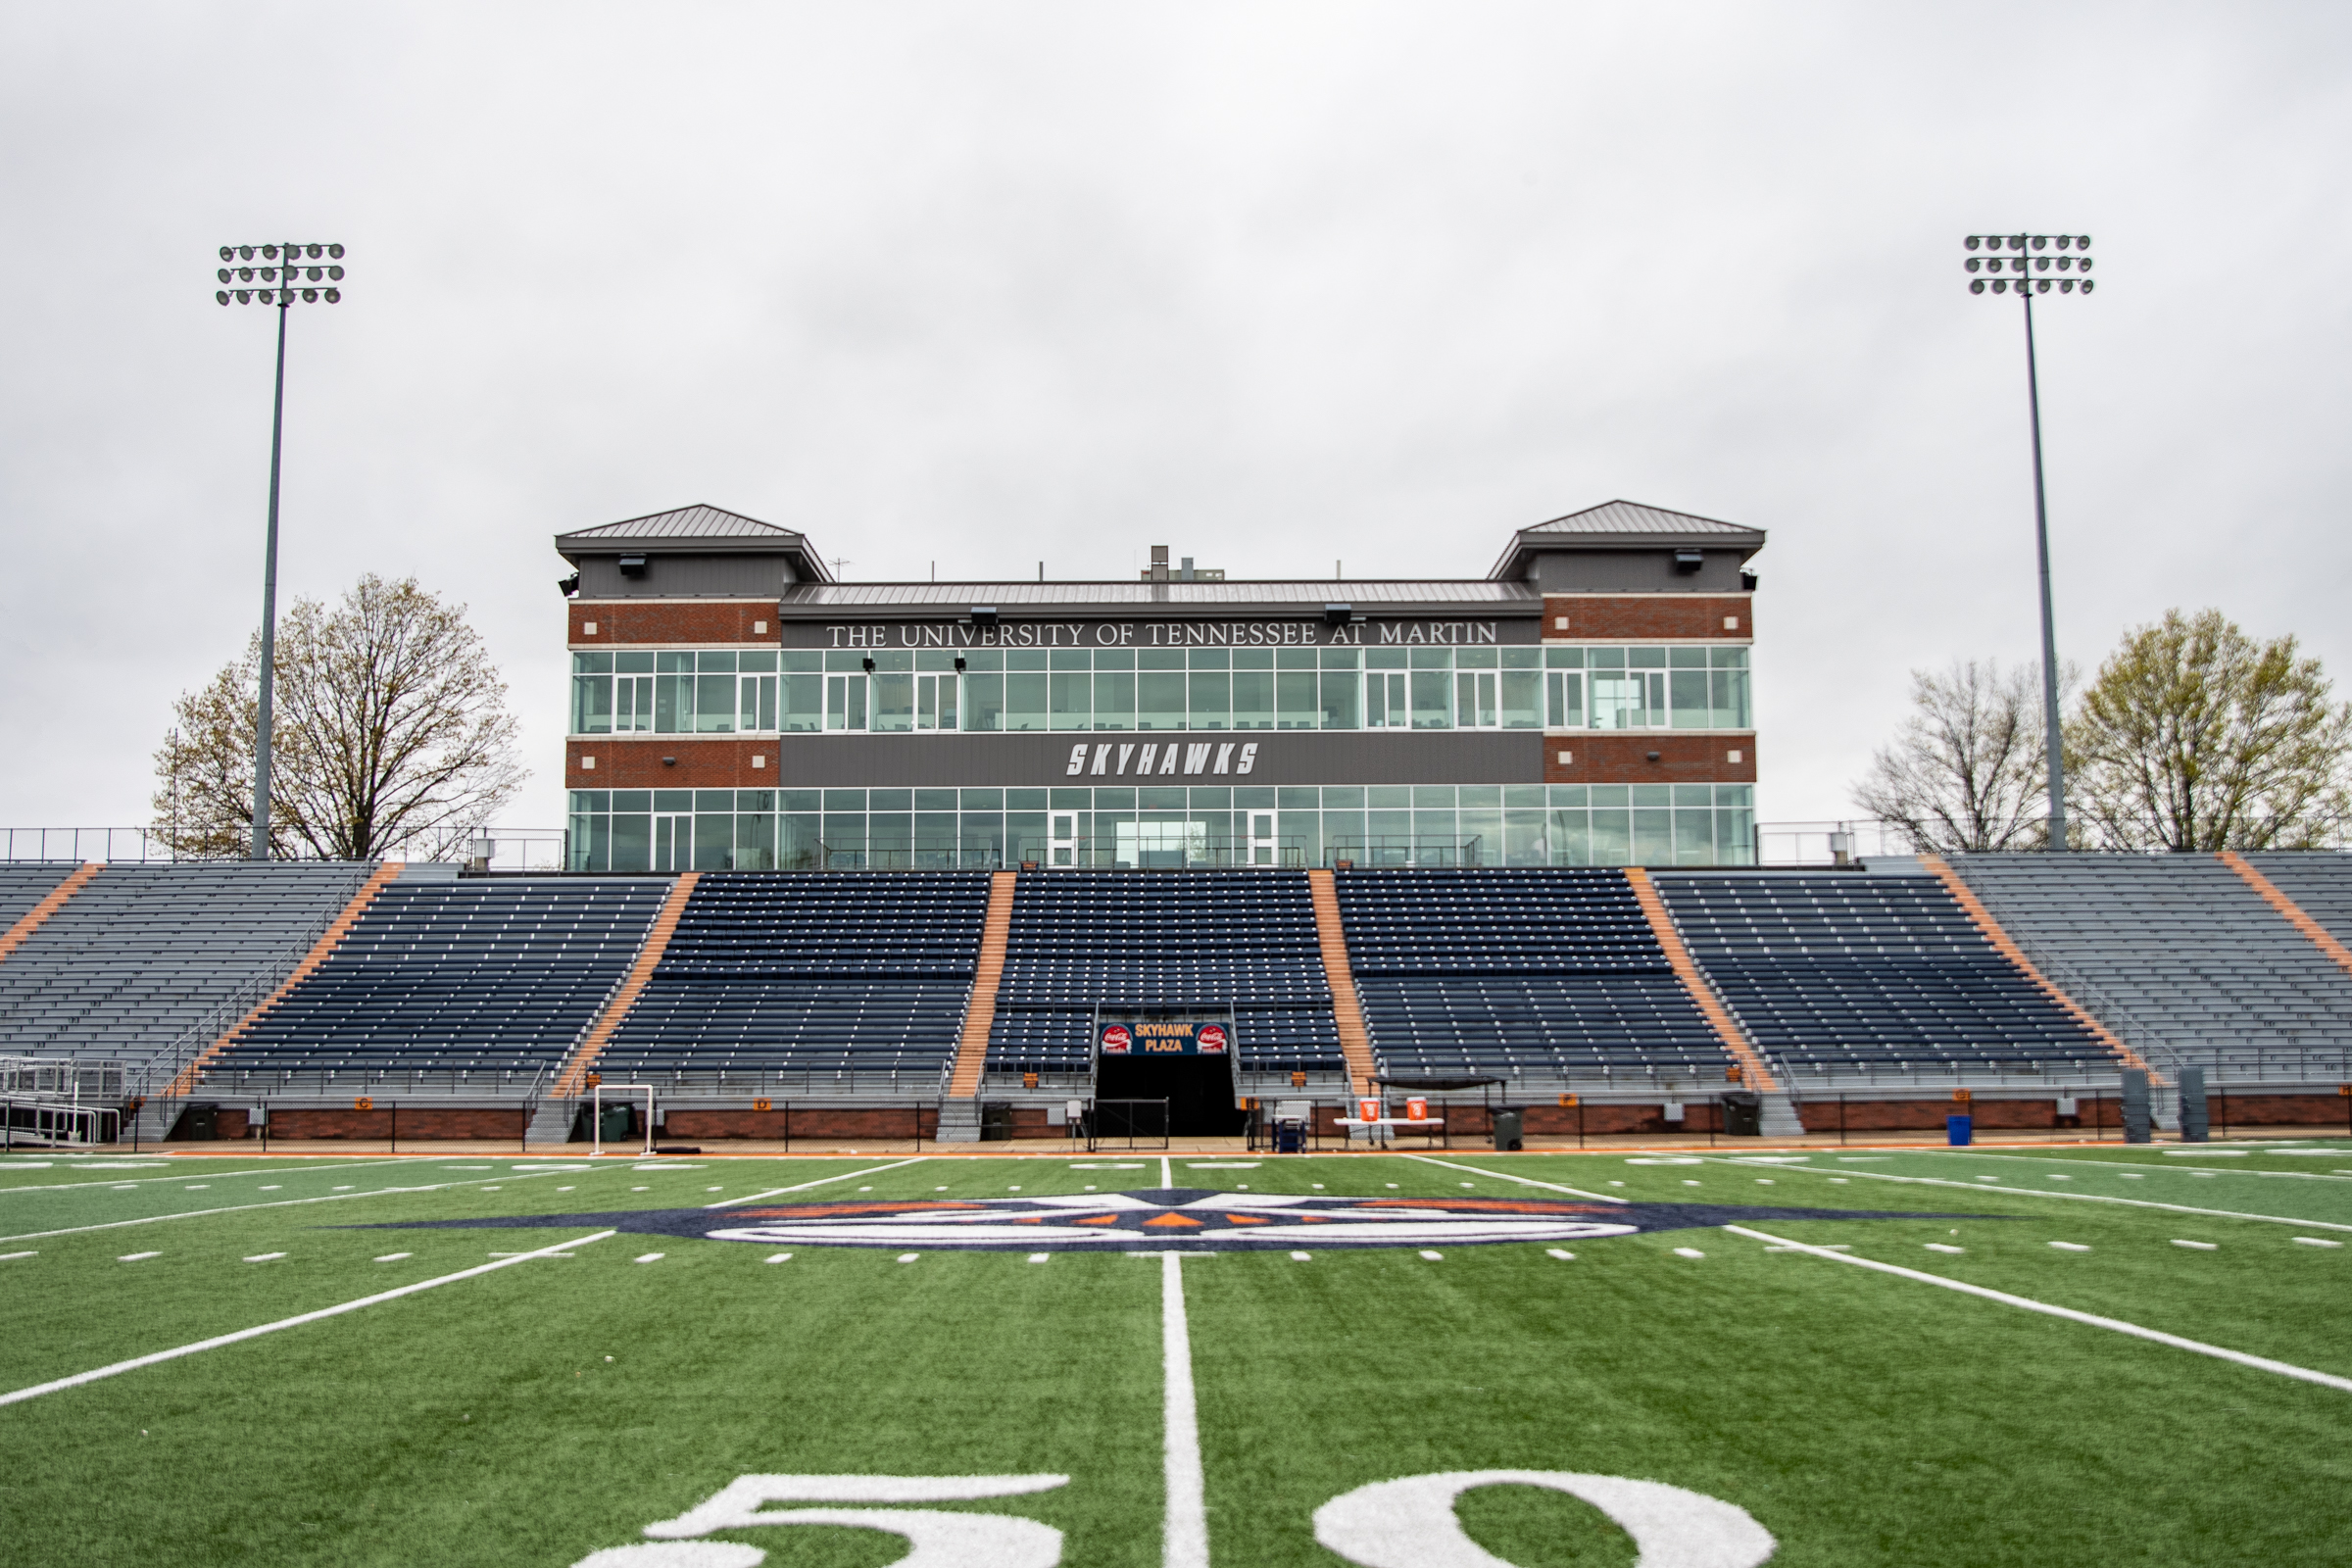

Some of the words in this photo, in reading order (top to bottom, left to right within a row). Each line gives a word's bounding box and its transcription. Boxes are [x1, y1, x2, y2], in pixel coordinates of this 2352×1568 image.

[826, 625, 887, 647] THE
[900, 624, 1085, 647] UNIVERSITY
[1096, 623, 1134, 646] OF
[1145, 622, 1317, 646] TENNESSEE
[1329, 622, 1367, 645] AT
[1379, 621, 1497, 644] MARTIN
[1065, 742, 1259, 776] SKYHAWKS
[1135, 1023, 1194, 1037] SKYHAWK
[1145, 1039, 1183, 1052] PLAZA
